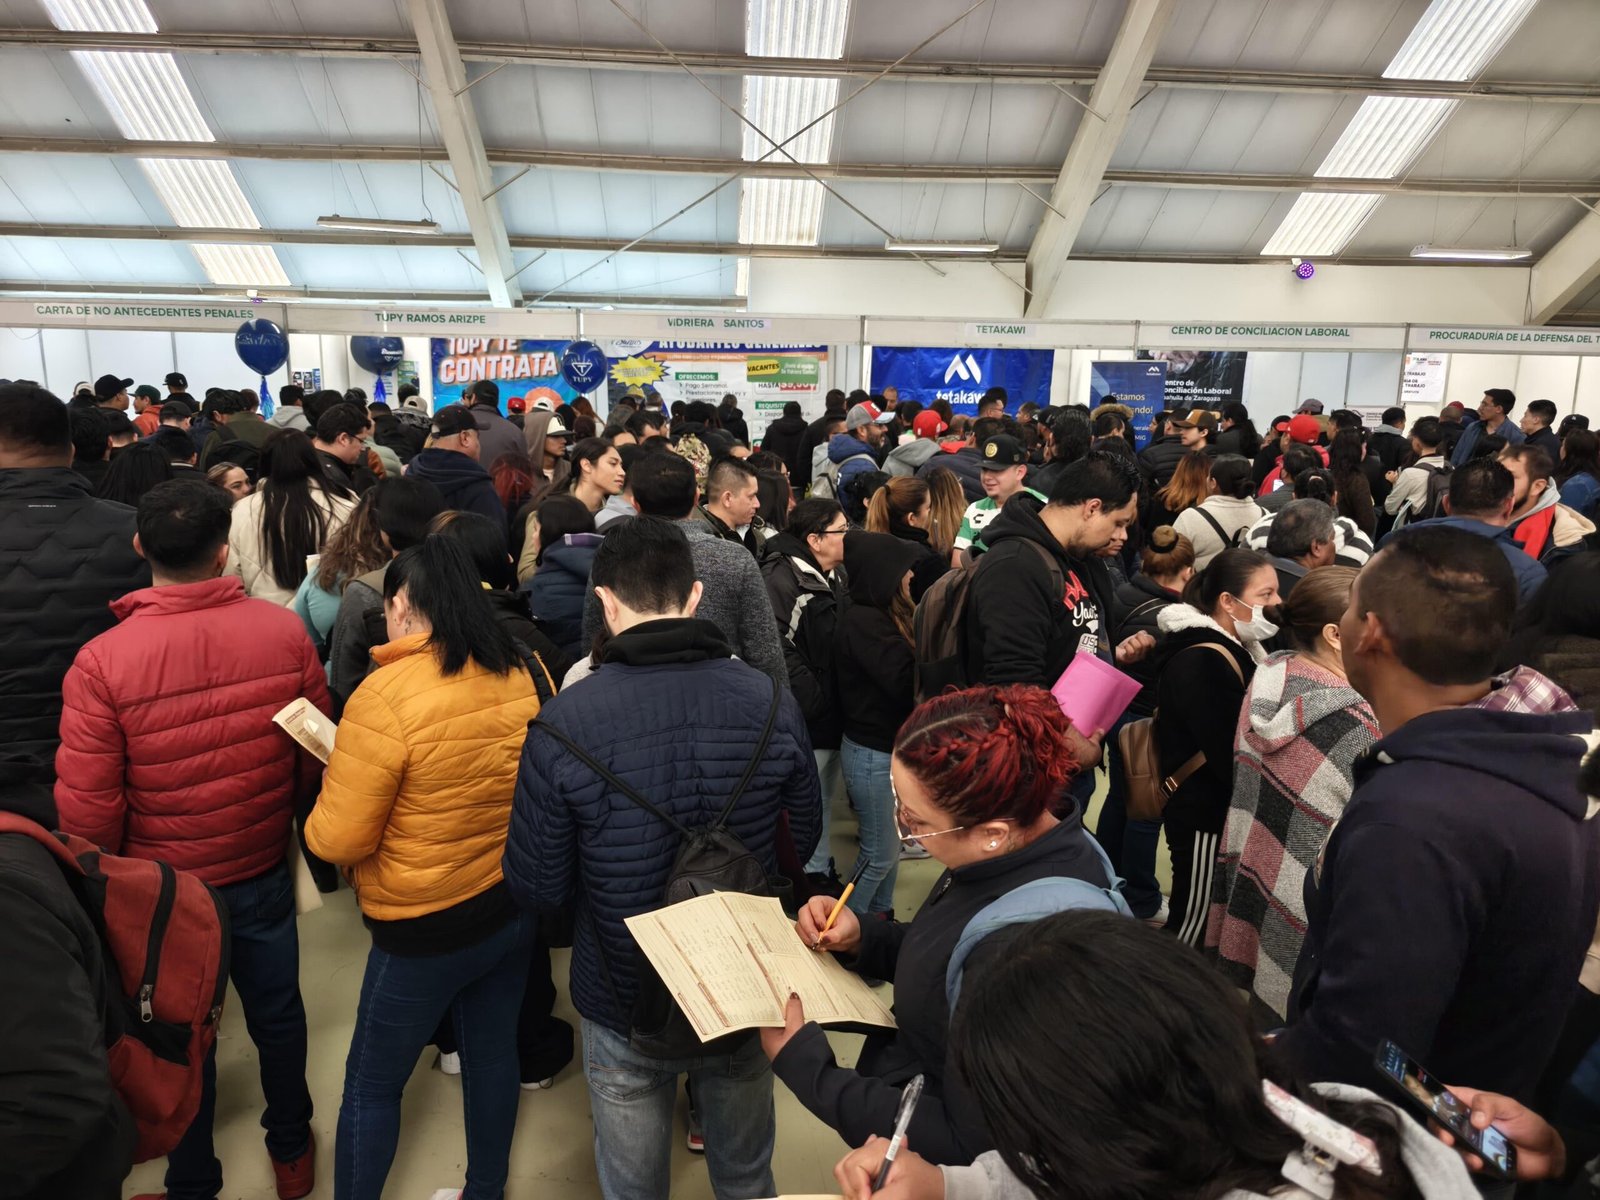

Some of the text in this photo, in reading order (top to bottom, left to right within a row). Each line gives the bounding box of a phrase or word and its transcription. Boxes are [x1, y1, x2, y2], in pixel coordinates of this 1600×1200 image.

[36, 305, 254, 319] CARTA DE NO ANTECEDENTES PENALES
[375, 313, 486, 324] TUPY RAMOS ARIZPE
[723, 319, 765, 329] SANTOS
[976, 325, 1026, 334] TETAKAWI
[1171, 326, 1350, 337] CENTRO DE CONCILIACION LABORAL
[1429, 330, 1504, 341] PROCURADURÍA
[1506, 332, 1518, 341] DE
[1520, 333, 1532, 342] LA
[1533, 333, 1574, 343] DEFENSA
[1576, 335, 1593, 344] DEL
[440, 351, 559, 384] CONTRATA
[747, 363, 780, 372] VACANTES
[1164, 386, 1232, 395] onciliación Laboral
[936, 390, 986, 404] tetakaw
